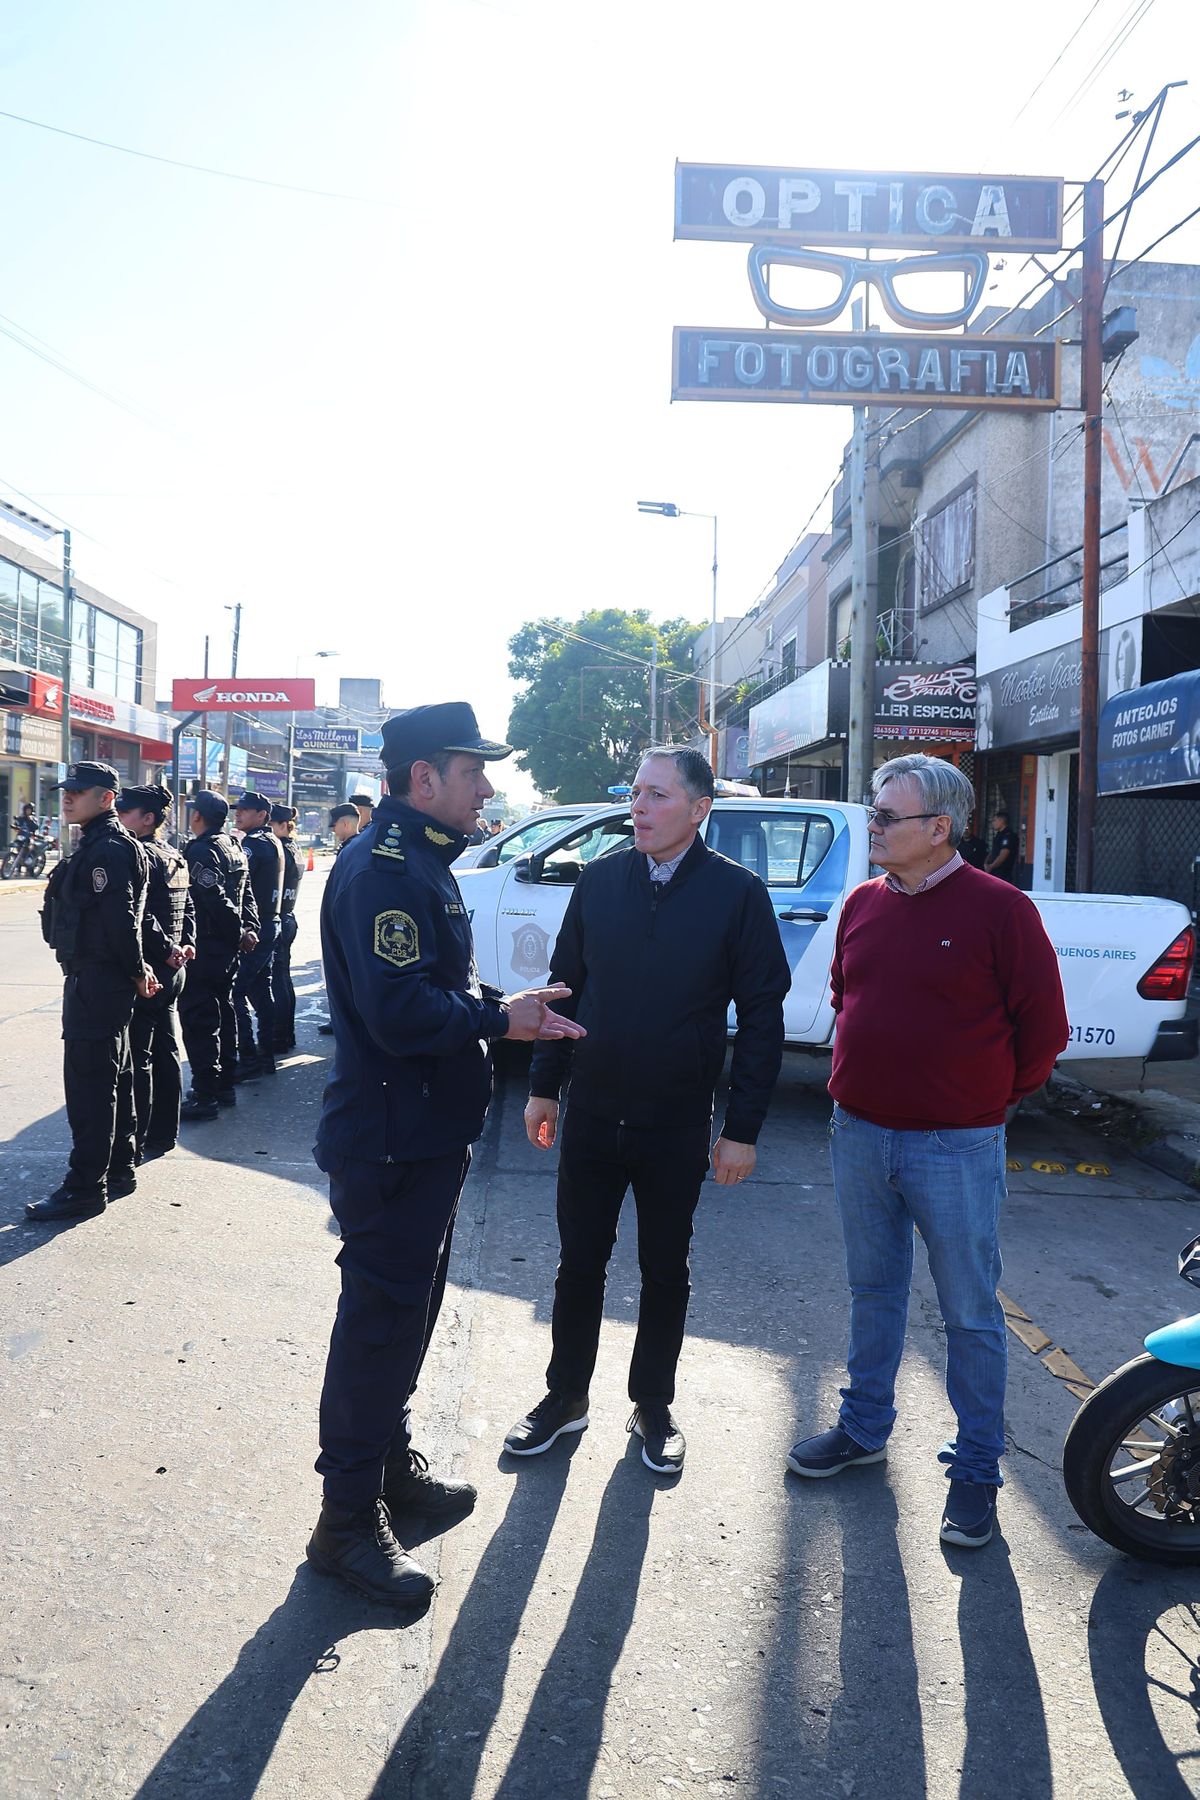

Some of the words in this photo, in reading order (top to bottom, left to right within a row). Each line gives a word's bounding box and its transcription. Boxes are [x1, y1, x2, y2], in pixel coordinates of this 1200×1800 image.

[722, 176, 1012, 237] OPTICA
[698, 339, 1032, 395] FOTOGRAFIA
[216, 692, 290, 703] HONDA
[1114, 697, 1178, 727] ANTEOJOS
[296, 729, 311, 740] Los
[312, 729, 357, 742] Millones
[303, 741, 349, 749] QUINIELA
[1112, 728, 1139, 749] FOTOS
[1140, 720, 1176, 742] CARNET
[1054, 947, 1100, 958] BUENOS
[1103, 949, 1136, 960] AIRES
